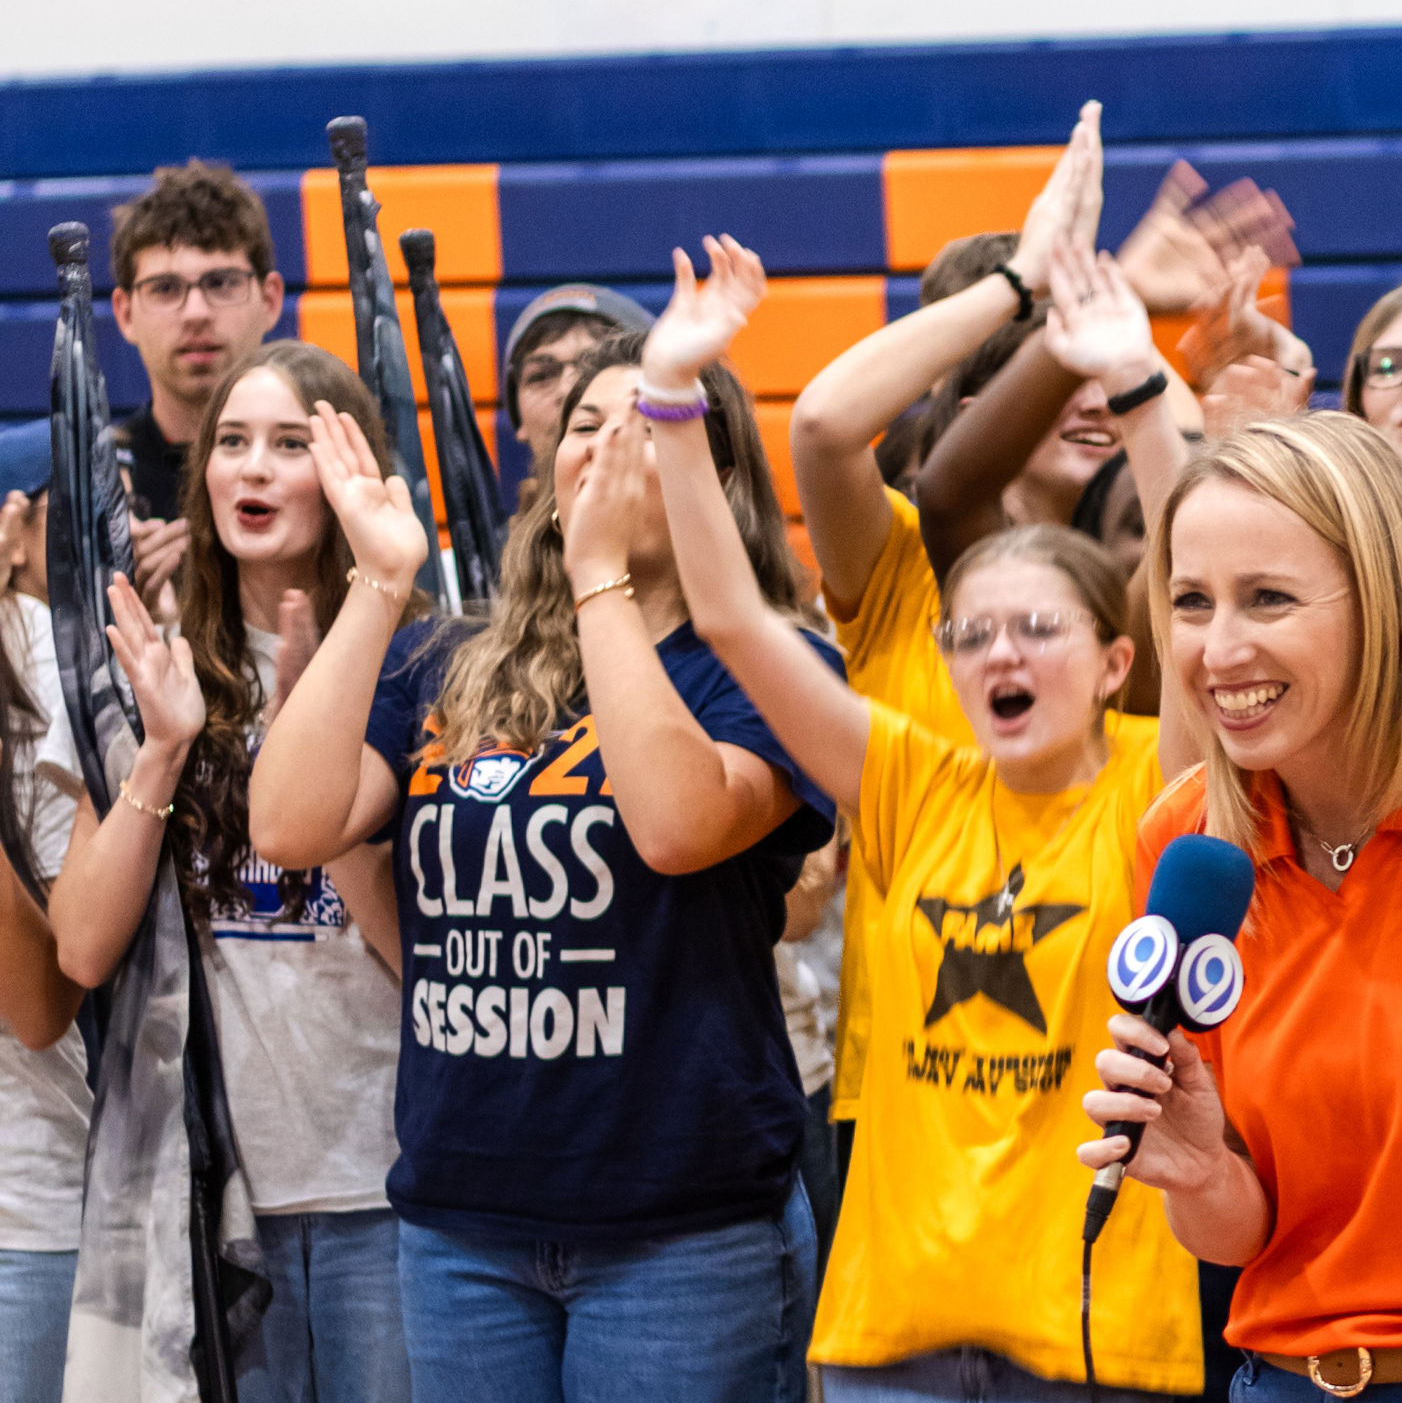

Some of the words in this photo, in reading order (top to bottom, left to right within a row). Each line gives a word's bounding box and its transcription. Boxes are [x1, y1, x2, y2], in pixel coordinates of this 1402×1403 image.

[409, 804, 615, 921] CLASS
[446, 929, 503, 978] OUT
[512, 932, 552, 980] OF
[412, 977, 627, 1060] SESSION
